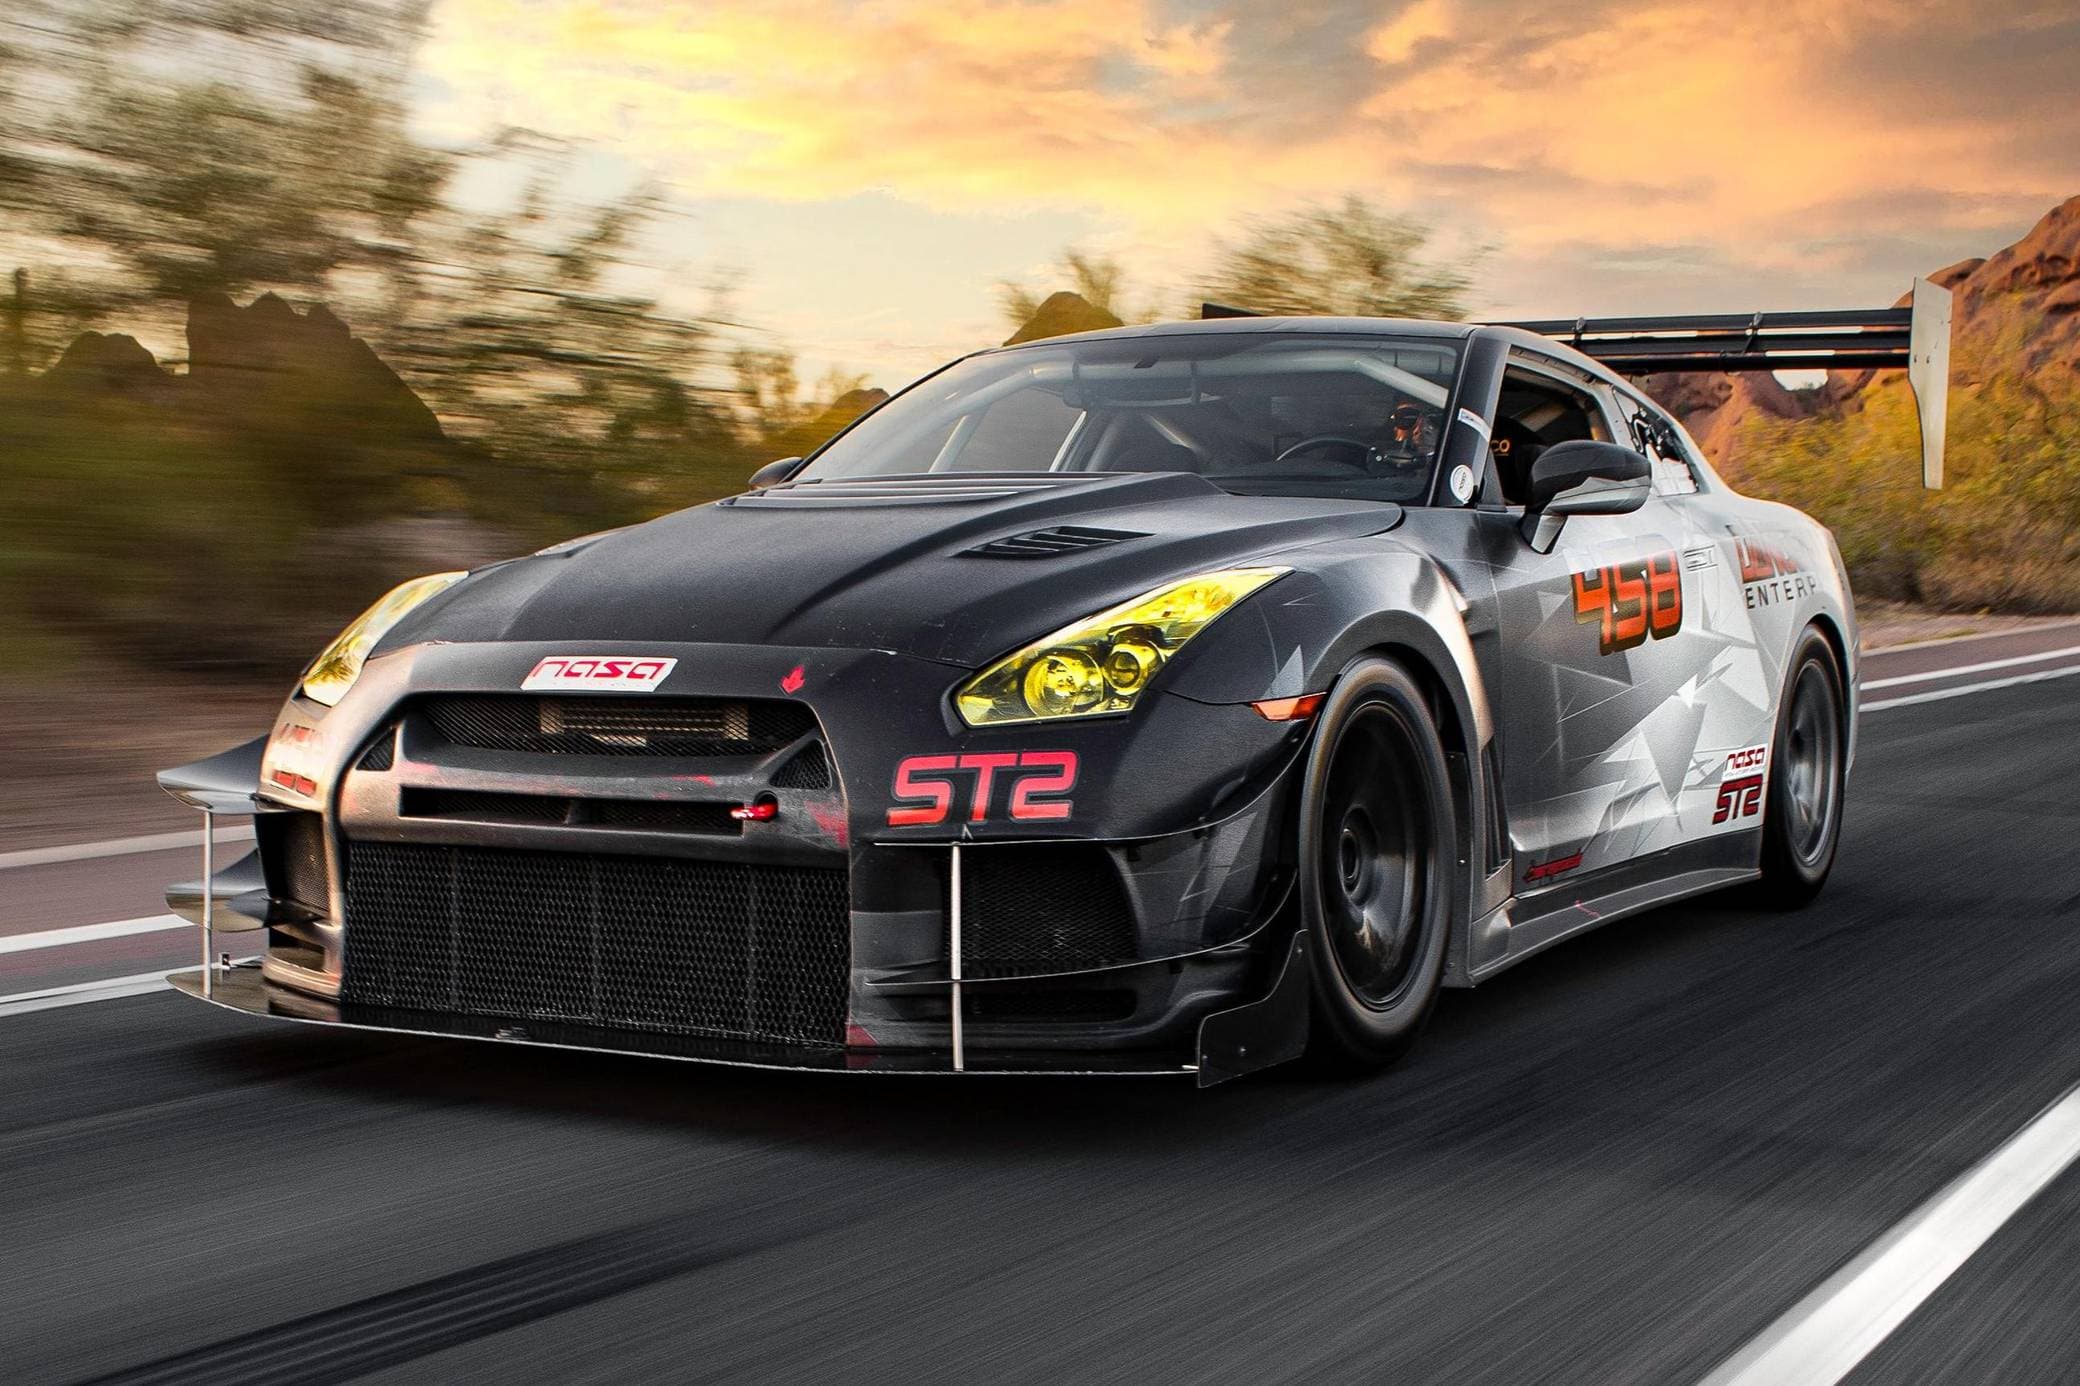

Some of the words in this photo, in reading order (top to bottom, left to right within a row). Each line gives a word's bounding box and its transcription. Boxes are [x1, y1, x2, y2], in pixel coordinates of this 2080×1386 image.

[1571, 545, 1683, 656] 458
[1745, 575, 1817, 610] ENTERP
[886, 750, 1079, 828] ST2
[1711, 773, 1764, 825] ST2
